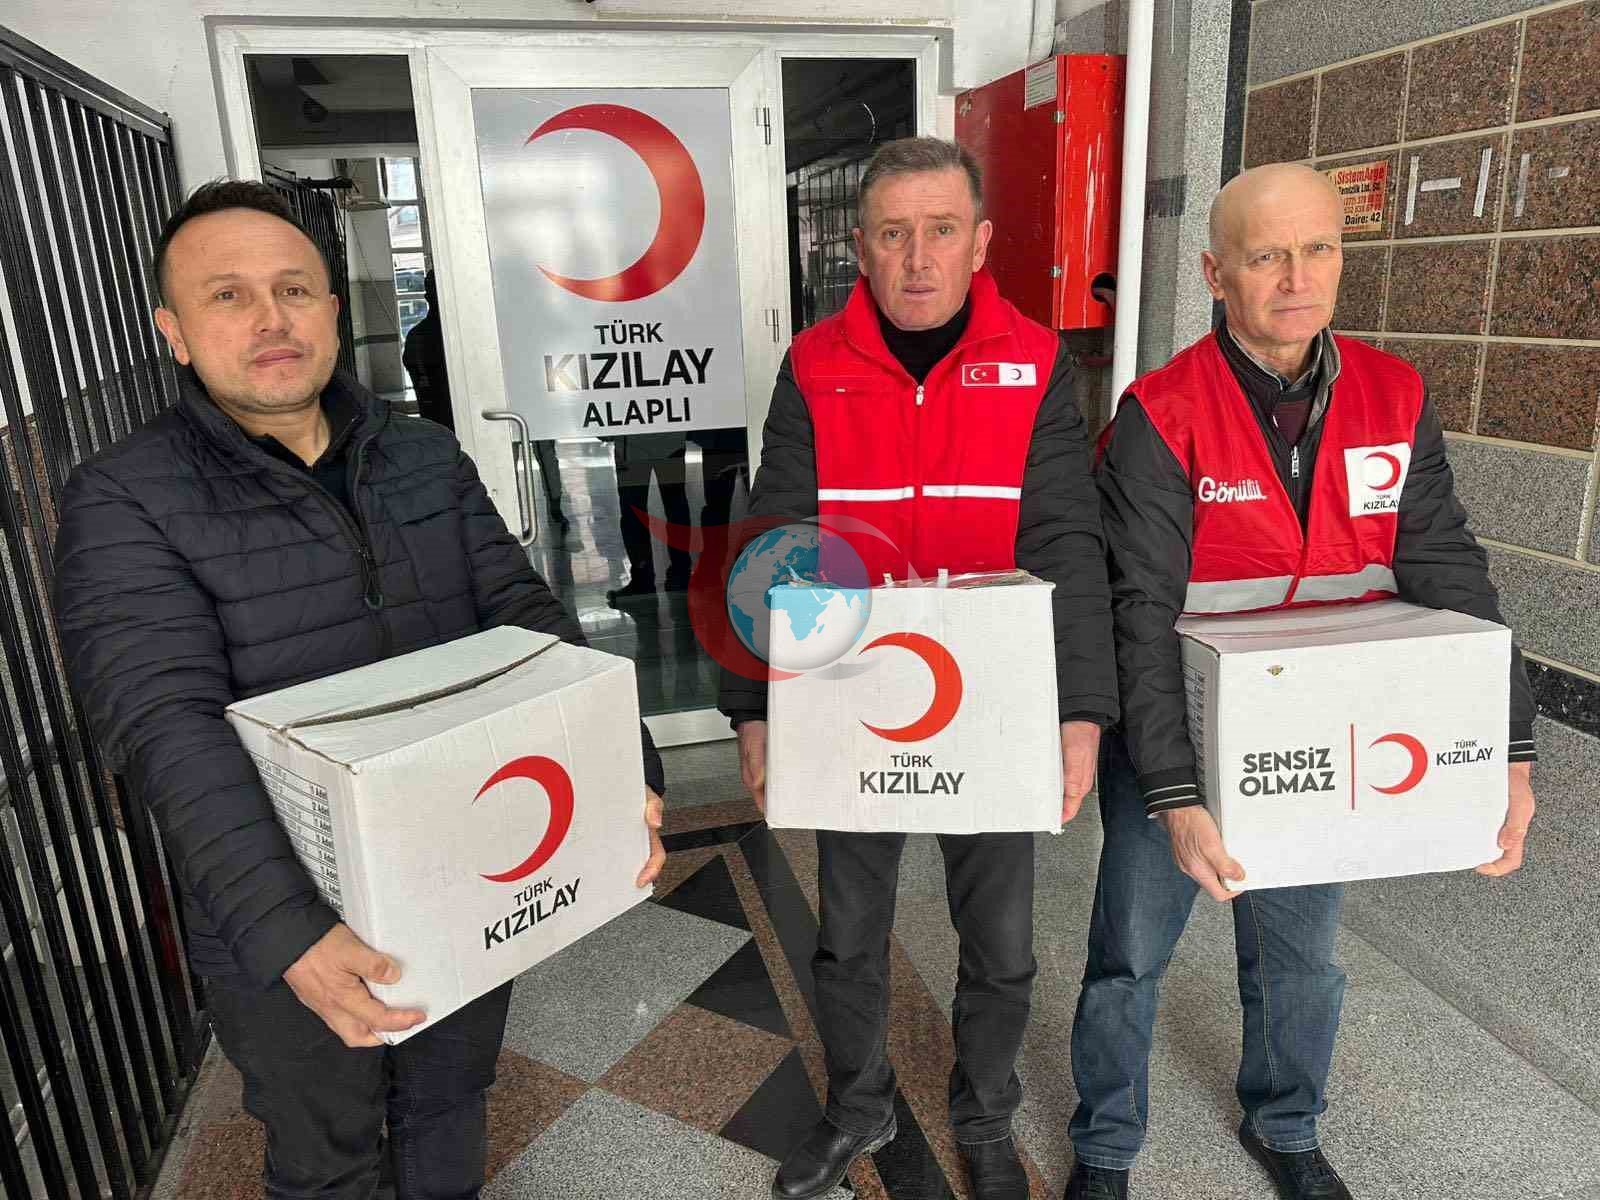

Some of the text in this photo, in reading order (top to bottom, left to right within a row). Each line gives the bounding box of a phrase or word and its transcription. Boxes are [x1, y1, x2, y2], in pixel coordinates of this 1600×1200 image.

[1345, 211, 1381, 225] Daire: 42
[594, 319, 664, 345] TÜRK
[544, 348, 714, 392] KIZILAY
[583, 397, 691, 428] ALAPLI
[1436, 747, 1494, 766] KIZILAY
[1455, 739, 1478, 749] TÜRK
[890, 752, 933, 768] TÜRK
[859, 771, 965, 795] KIZILAY
[1239, 771, 1336, 797] OLMAZ
[514, 876, 554, 906] TÜRK
[484, 878, 581, 950] KIZILAY
